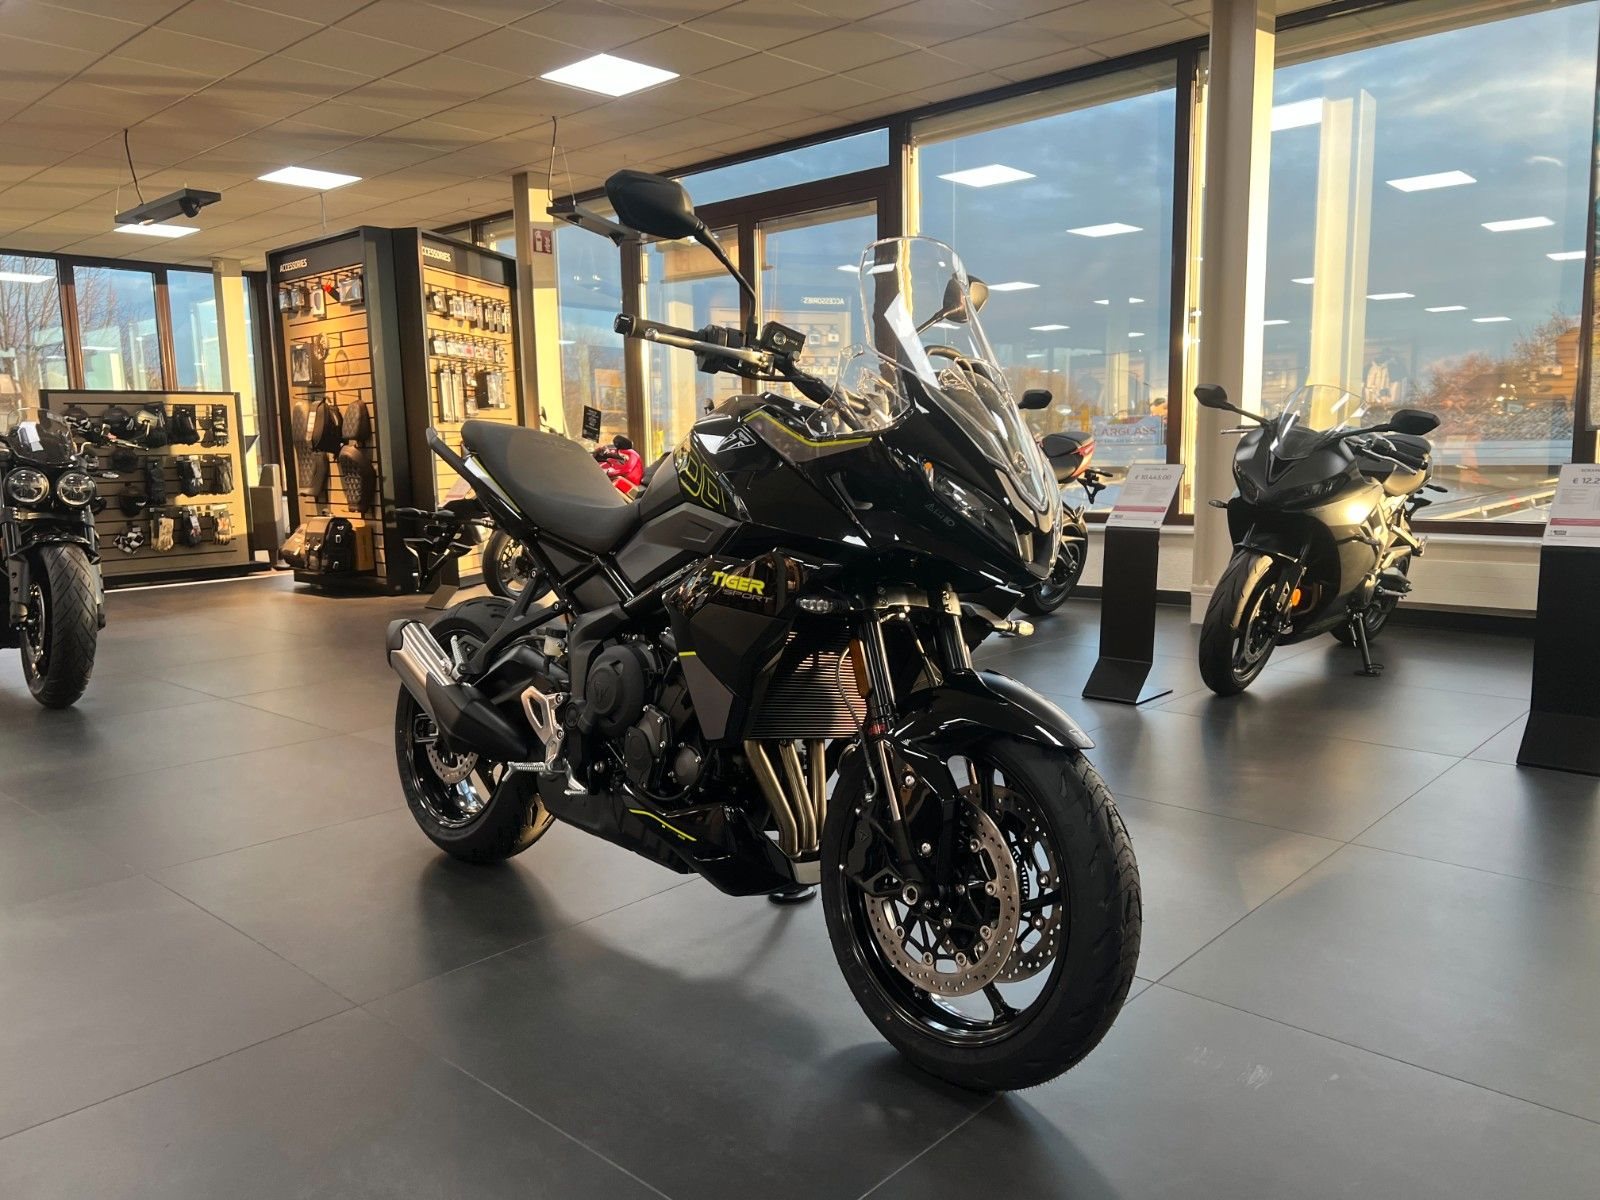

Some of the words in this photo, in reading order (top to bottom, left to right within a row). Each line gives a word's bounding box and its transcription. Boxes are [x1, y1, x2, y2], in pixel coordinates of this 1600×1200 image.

[422, 246, 451, 262] CCESSORIES
[280, 258, 308, 273] ACCESSORIES
[712, 570, 765, 595] TIGER
[723, 588, 773, 603] SPORT
